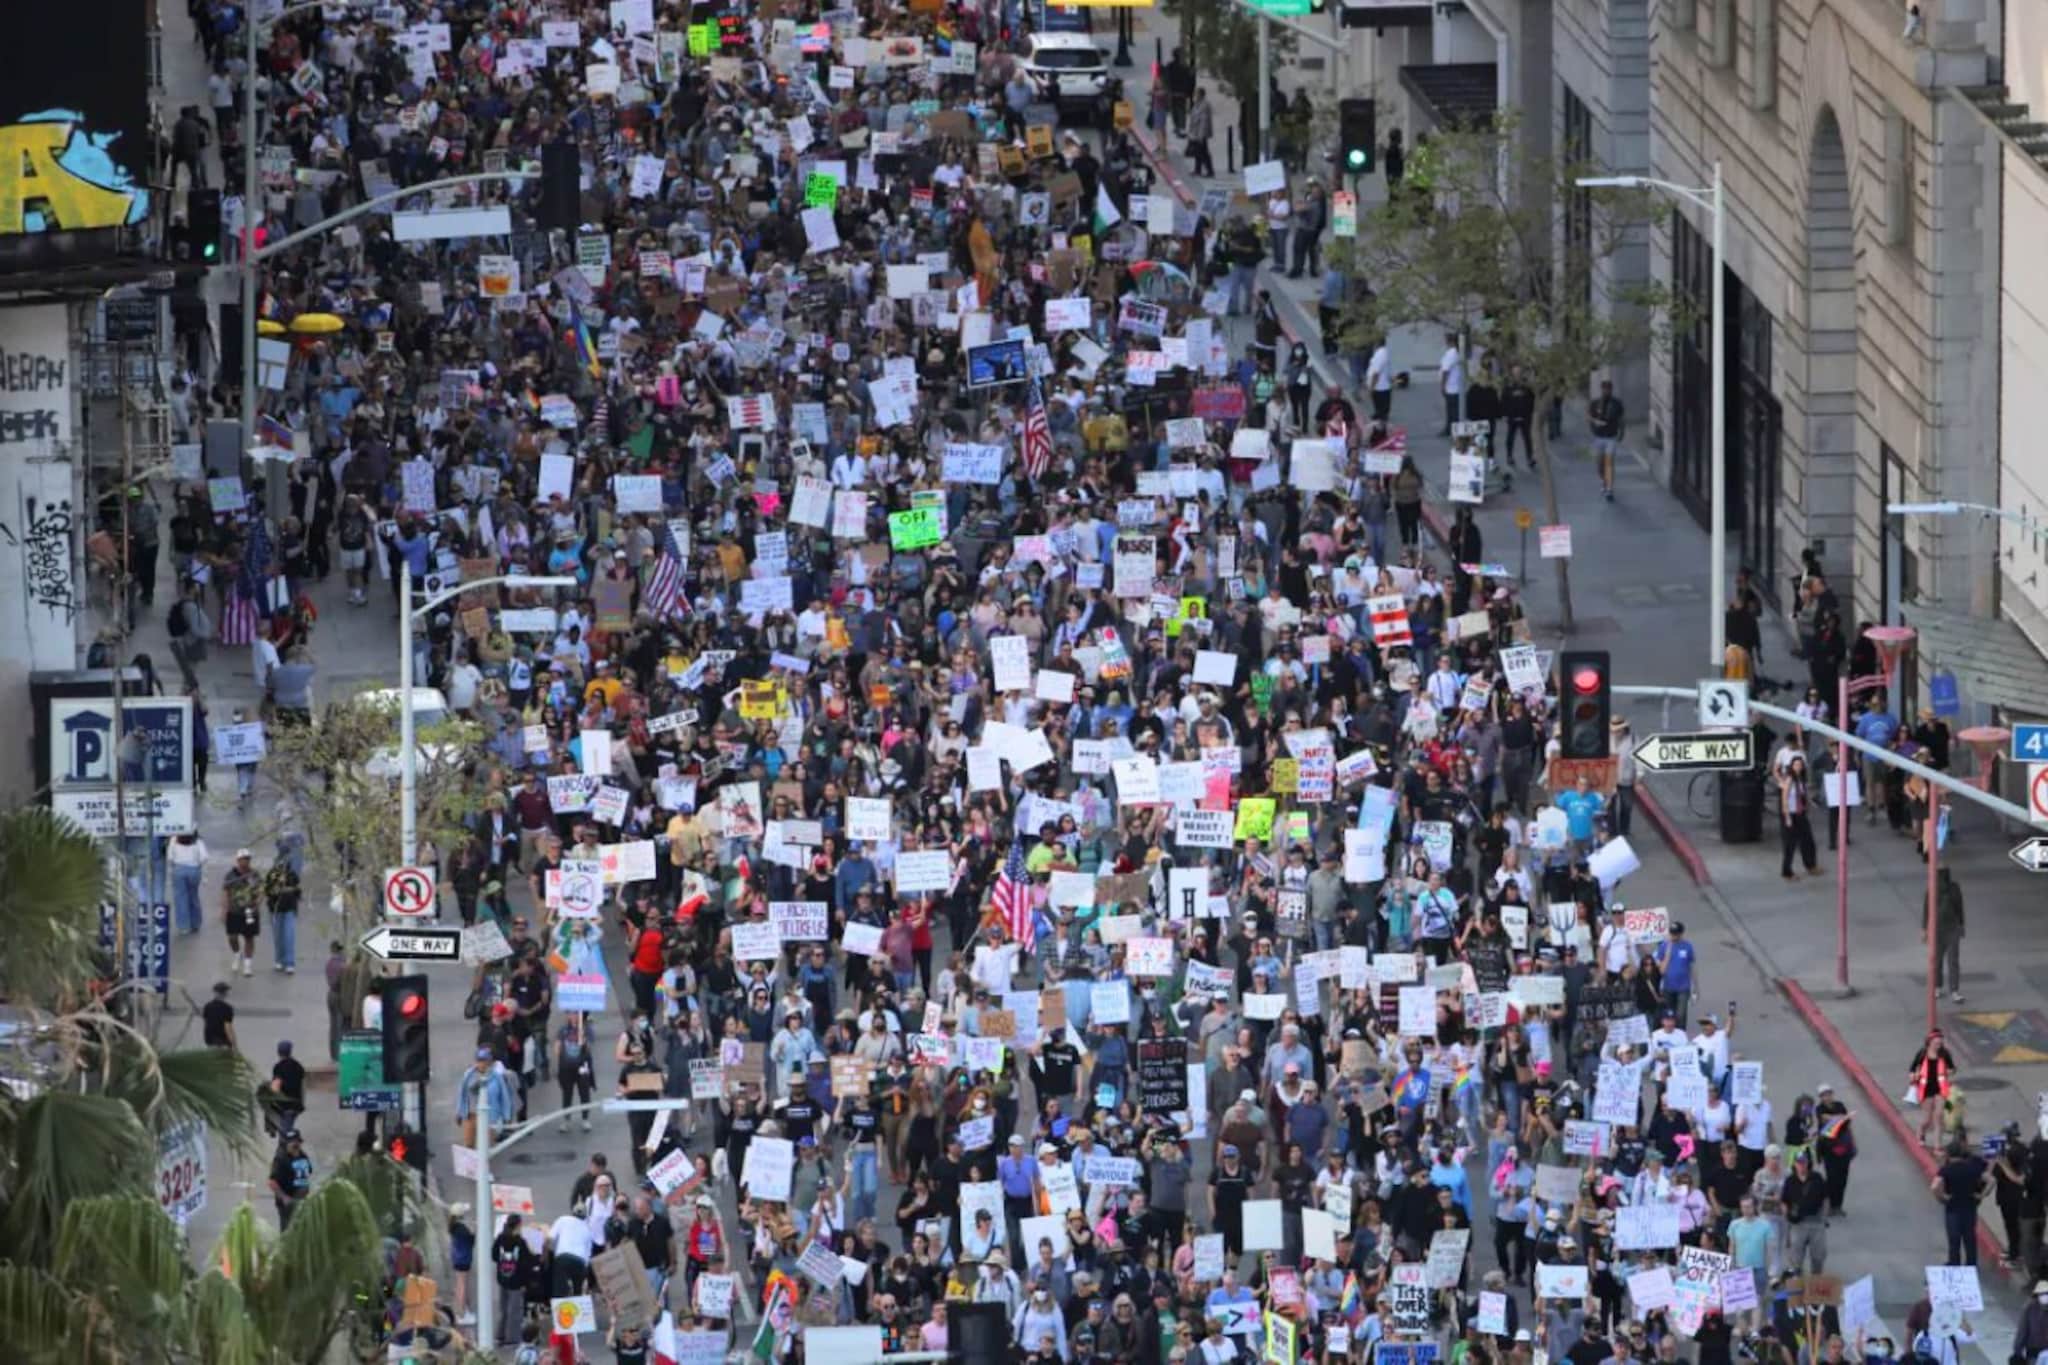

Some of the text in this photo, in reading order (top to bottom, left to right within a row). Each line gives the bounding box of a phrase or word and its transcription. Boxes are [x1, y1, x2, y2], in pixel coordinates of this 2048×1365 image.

[899, 511, 927, 525] OFF
[77, 730, 102, 779] P
[1658, 743, 1741, 761] ONE WAY
[390, 937, 450, 952] ONE WAY
[1143, 1092, 1181, 1108] JUDGES
[161, 1158, 192, 1206] 320
[1685, 1248, 1728, 1272] HANDS
[1687, 1266, 1718, 1284] OFF
[1395, 1284, 1426, 1300] Tits
[1394, 1299, 1429, 1313] OVER
